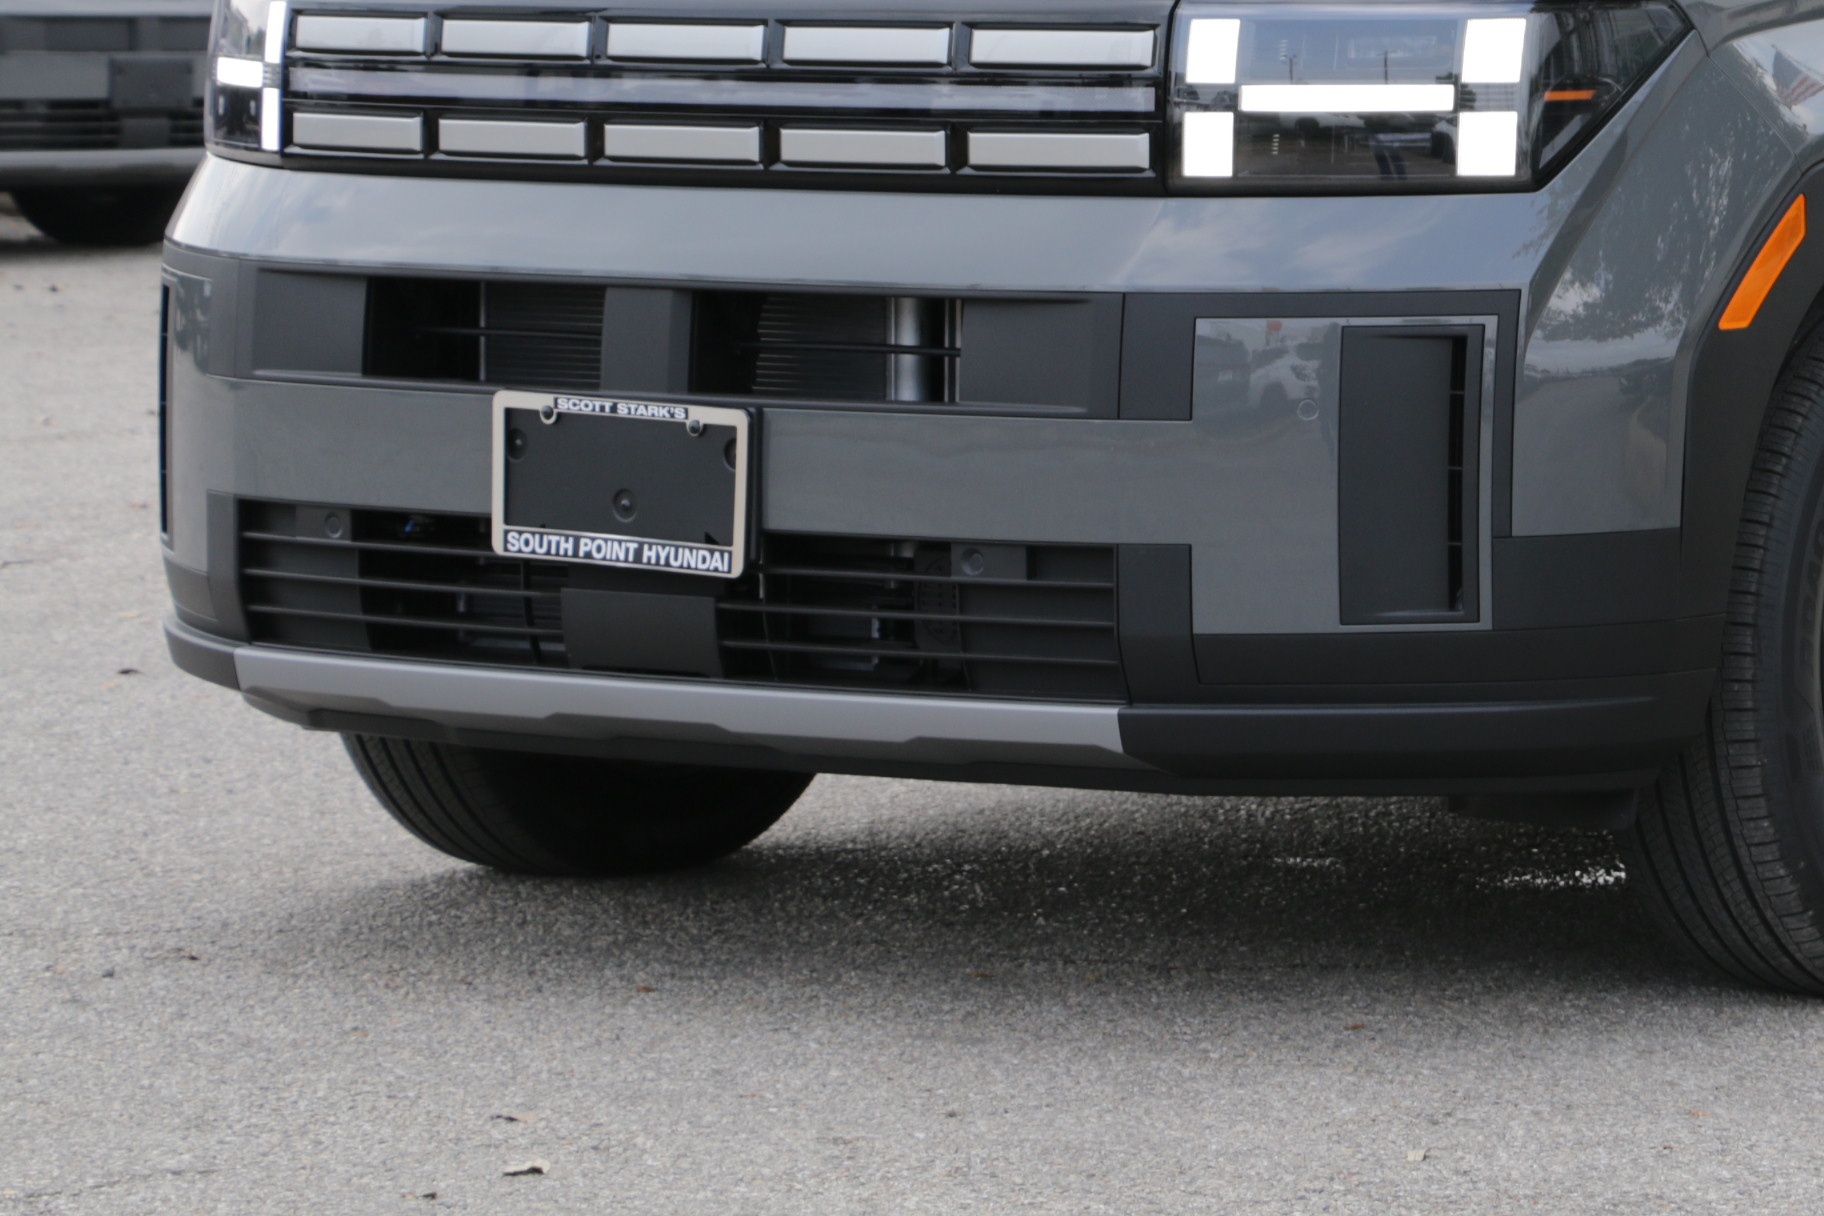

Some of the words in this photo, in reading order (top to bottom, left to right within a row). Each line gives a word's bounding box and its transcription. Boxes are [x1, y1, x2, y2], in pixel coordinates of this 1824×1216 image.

[557, 398, 613, 413] SCOTT
[617, 404, 686, 419] STARK'S
[506, 531, 574, 557] SOUTH
[578, 537, 639, 563] POINT
[643, 544, 730, 572] HYUNDAI
